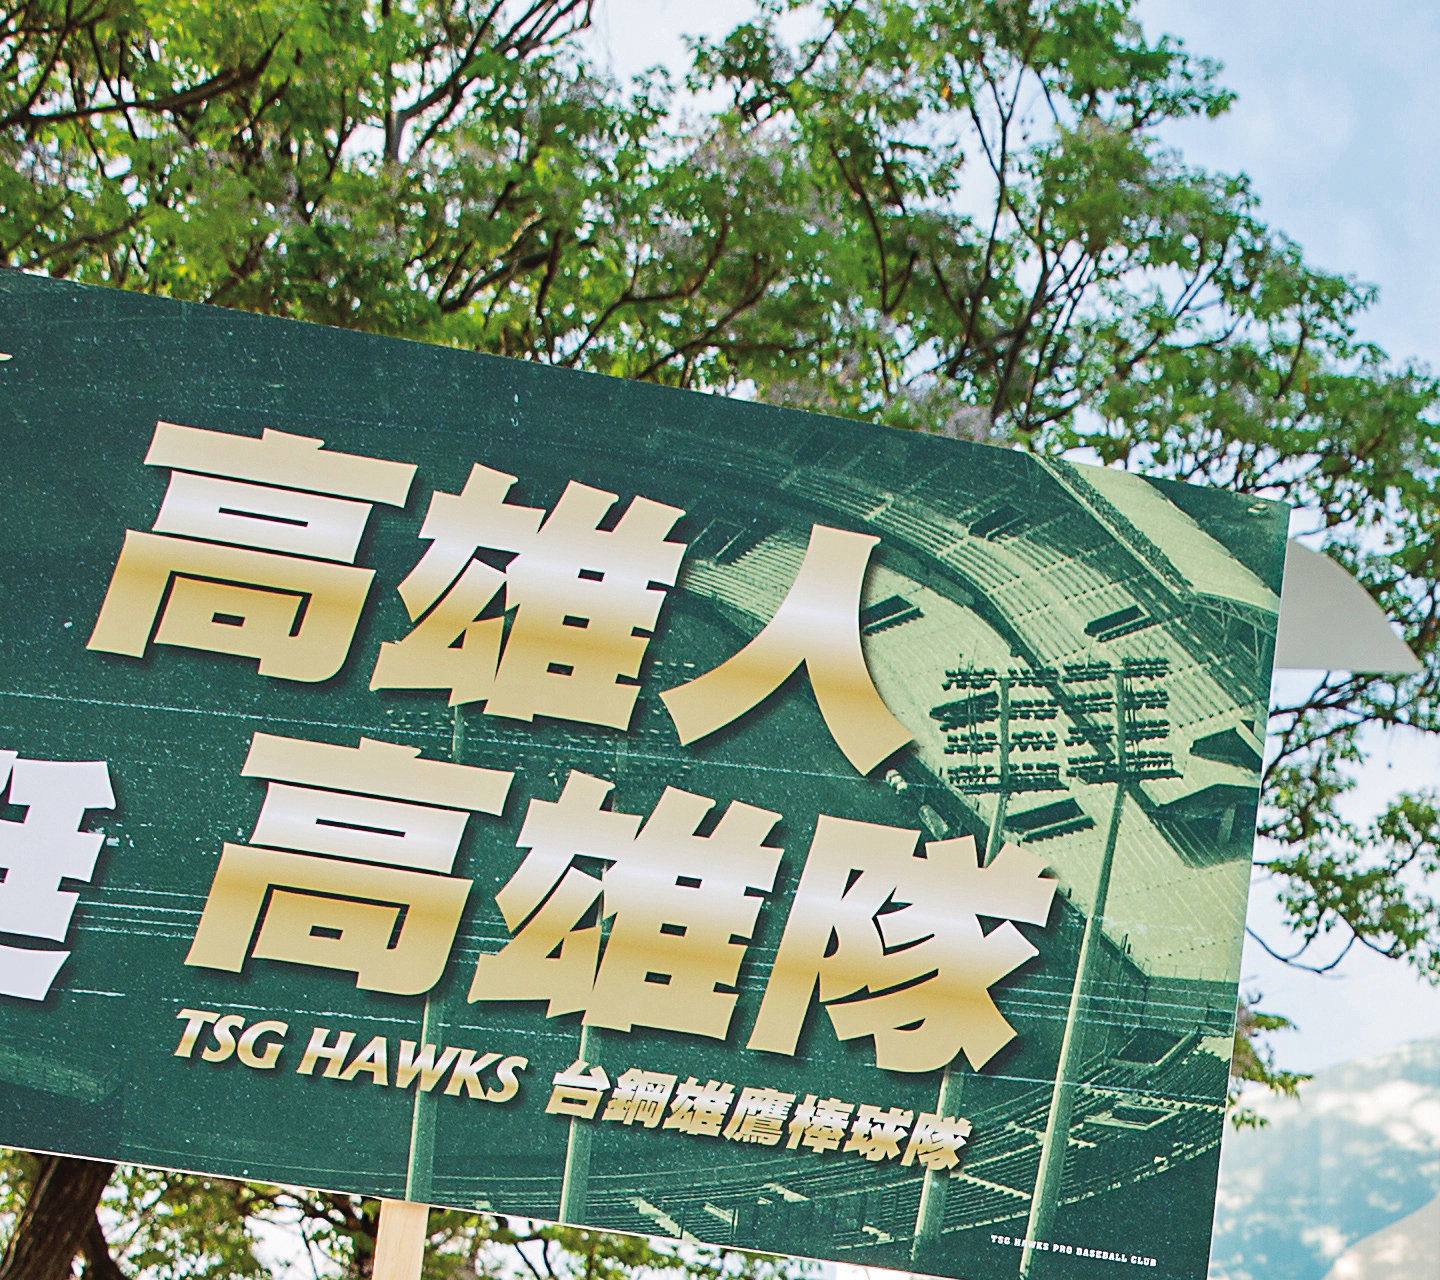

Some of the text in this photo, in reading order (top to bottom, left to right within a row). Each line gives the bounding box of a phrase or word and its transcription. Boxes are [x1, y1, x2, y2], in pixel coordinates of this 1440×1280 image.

[87, 420, 914, 778] 高雄人
[183, 731, 1058, 1076] 高雄隊
[172, 1007, 973, 1174] TSG HAWKS 台鋼雄鷹棒球隊
[990, 1234, 1011, 1246] TSG
[1052, 1242, 1073, 1255] PRO
[1076, 1246, 1128, 1264] BASEBALL
[1130, 1255, 1157, 1267] CLUB
